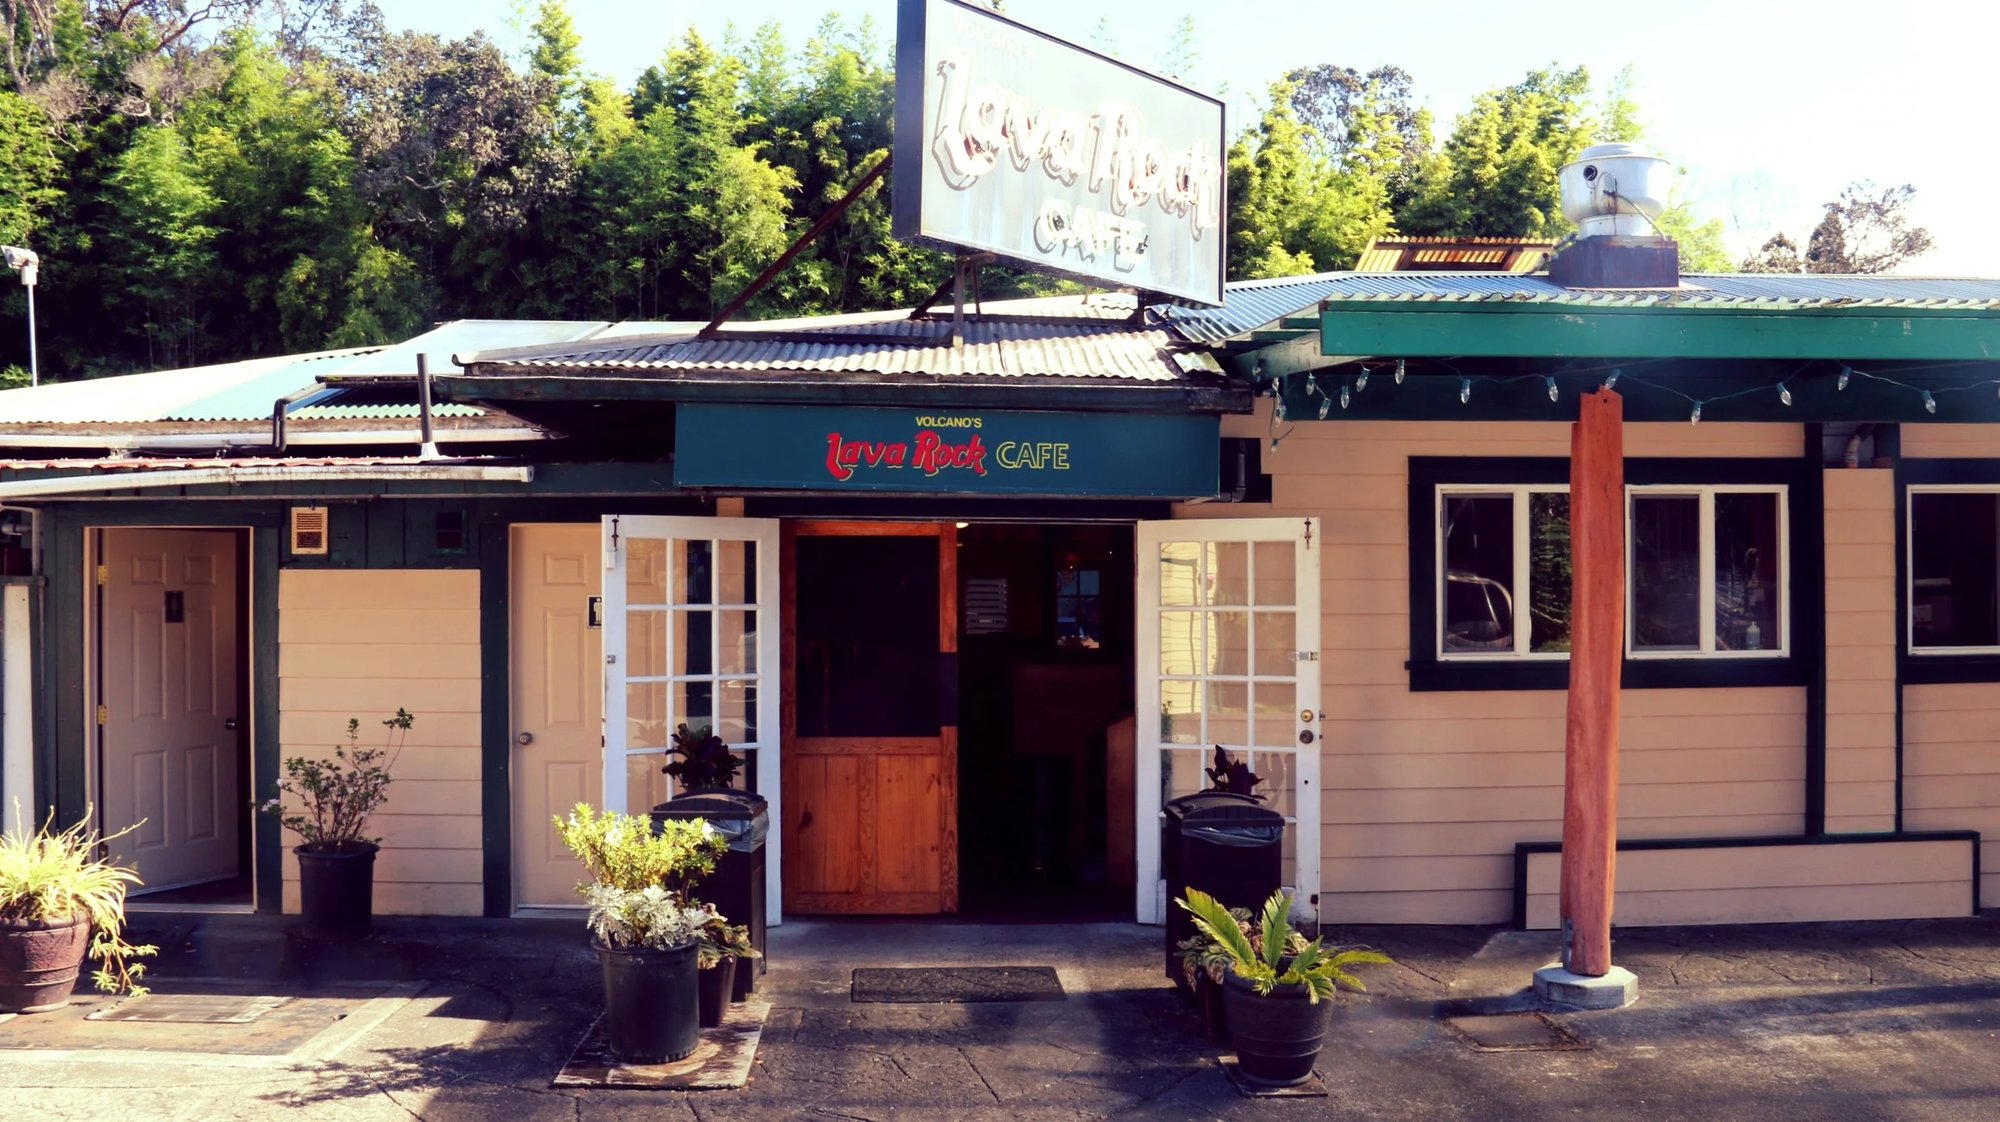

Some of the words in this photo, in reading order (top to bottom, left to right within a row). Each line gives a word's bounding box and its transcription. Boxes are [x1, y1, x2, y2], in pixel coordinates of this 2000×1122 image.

[931, 49, 1087, 191] Lava
[915, 416, 982, 428] VOLCANO'S
[827, 432, 907, 481] Lava
[911, 430, 988, 477] Rock
[996, 441, 1070, 470] CAFE
